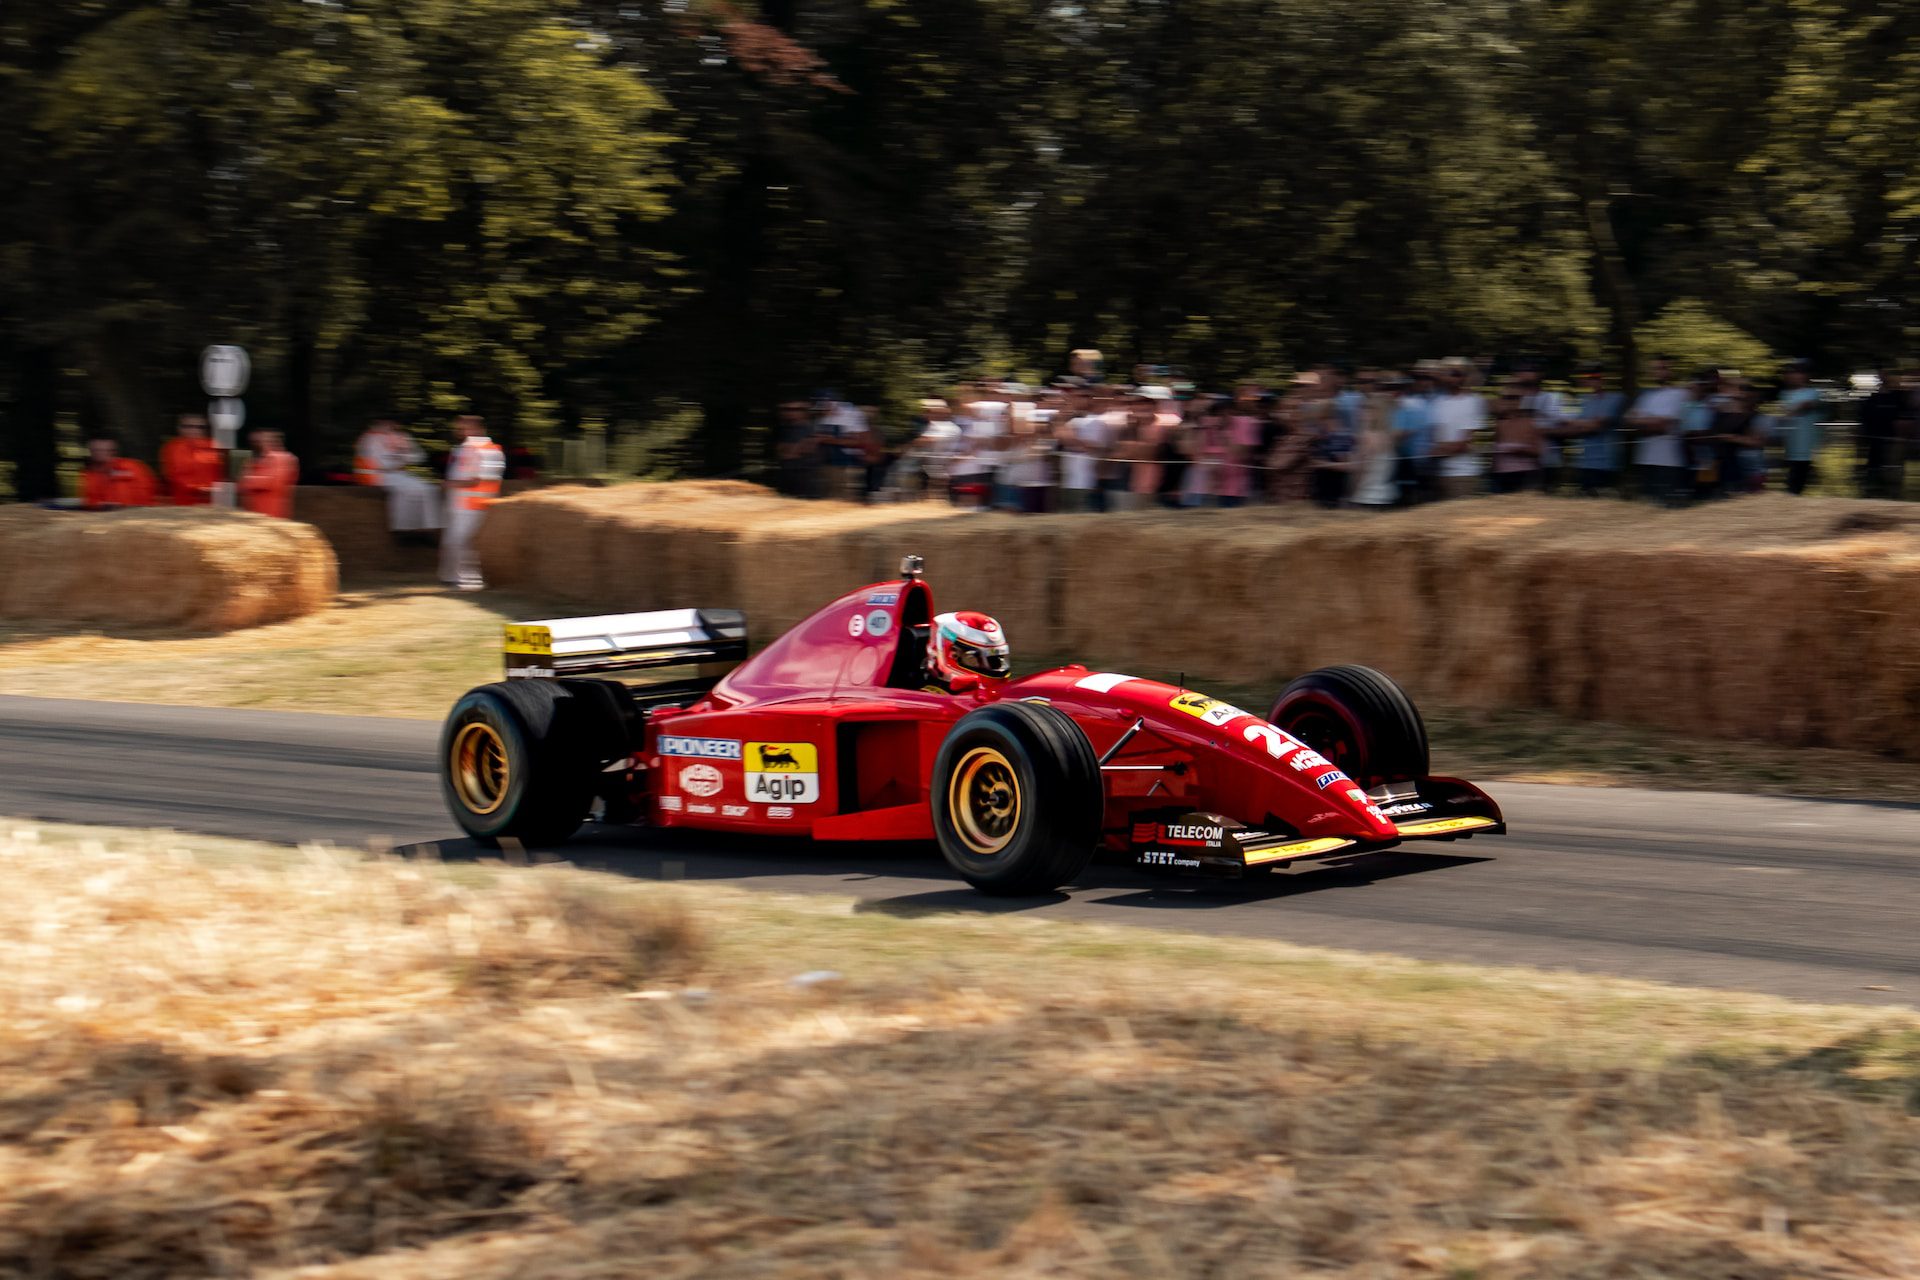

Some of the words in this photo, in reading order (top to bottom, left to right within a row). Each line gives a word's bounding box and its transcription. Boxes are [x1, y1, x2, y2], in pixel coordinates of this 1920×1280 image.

[663, 737, 741, 757] PIONEER
[756, 774, 805, 799] Agip
[1167, 825, 1224, 840] TELECOM
[1205, 840, 1222, 848] ITALIA
[1143, 852, 1175, 864] STET
[1174, 859, 1200, 867] company
